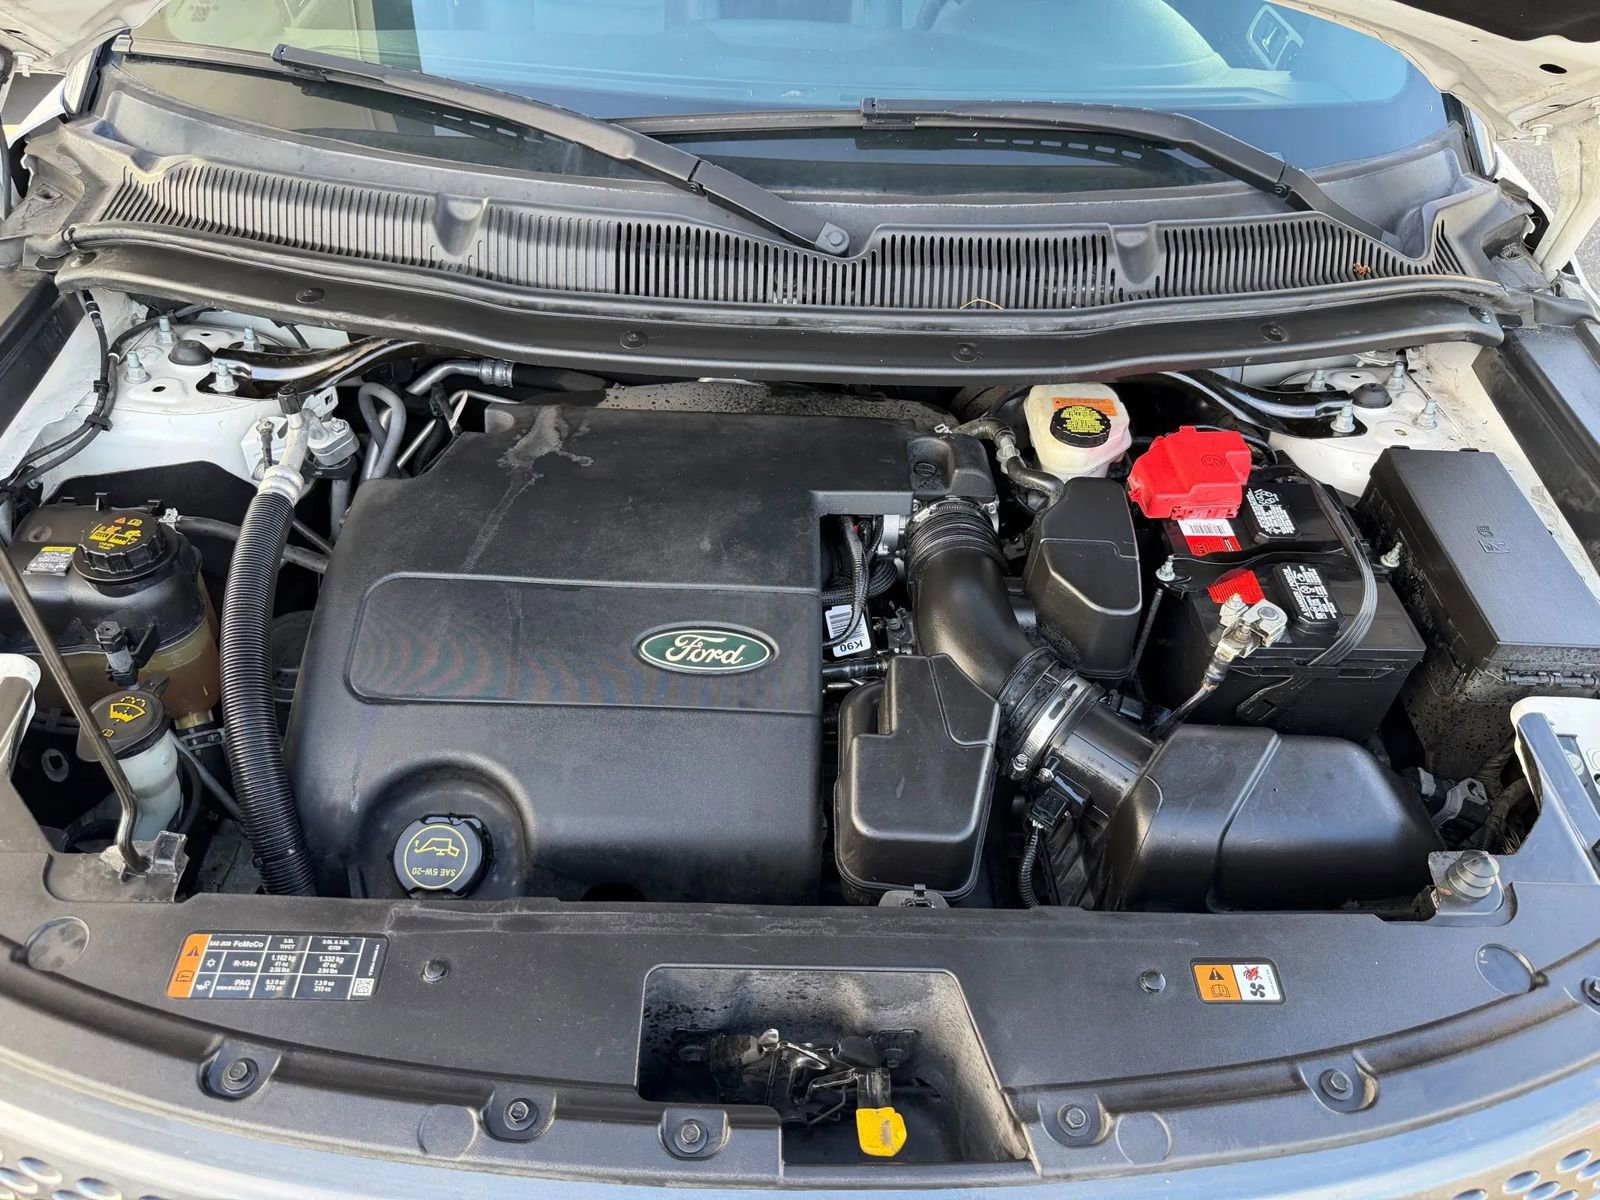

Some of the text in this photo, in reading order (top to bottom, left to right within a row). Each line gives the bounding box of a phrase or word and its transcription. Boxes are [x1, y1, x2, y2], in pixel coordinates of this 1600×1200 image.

[665, 634, 747, 665] Ford
[840, 640, 863, 652] K90
[411, 867, 456, 877] SAE 5W-20
[233, 940, 264, 948] FoMoCo
